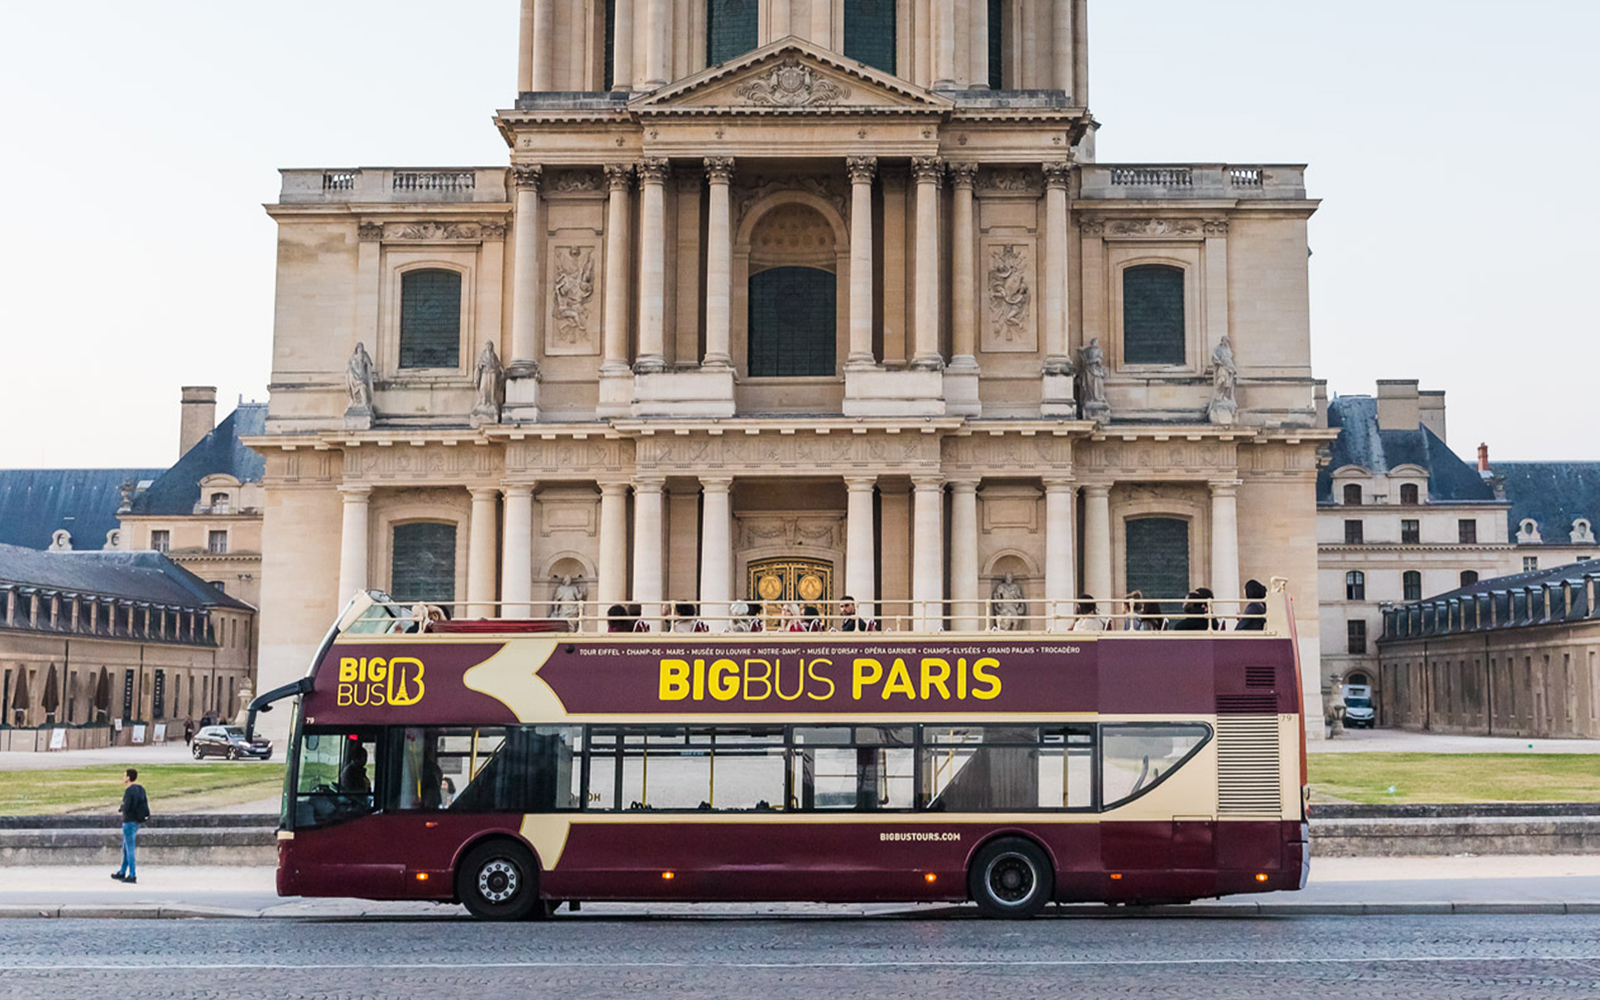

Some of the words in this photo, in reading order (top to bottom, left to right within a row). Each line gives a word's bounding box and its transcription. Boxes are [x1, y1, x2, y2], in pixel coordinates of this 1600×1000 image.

[579, 648, 597, 656] TOUR
[598, 648, 620, 656] EIFFEL
[666, 648, 685, 656] MARS
[691, 647, 714, 656] MUSÉE
[715, 648, 725, 656] DU
[726, 648, 751, 656] LOUVRE
[807, 646, 830, 655] MUSÉE
[831, 647, 858, 655] D'ORSAY
[864, 646, 887, 655] OPÉRA
[888, 647, 917, 655] GARNIER
[986, 646, 1011, 654] GRAND
[1011, 646, 1035, 654] PALAIS
[1040, 645, 1081, 654] TROCADÉRO
[339, 657, 387, 682] BIG
[852, 657, 1002, 701] PARIS
[337, 683, 386, 706] BUS
[880, 832, 961, 841] BIGBUSTOURS.COM
